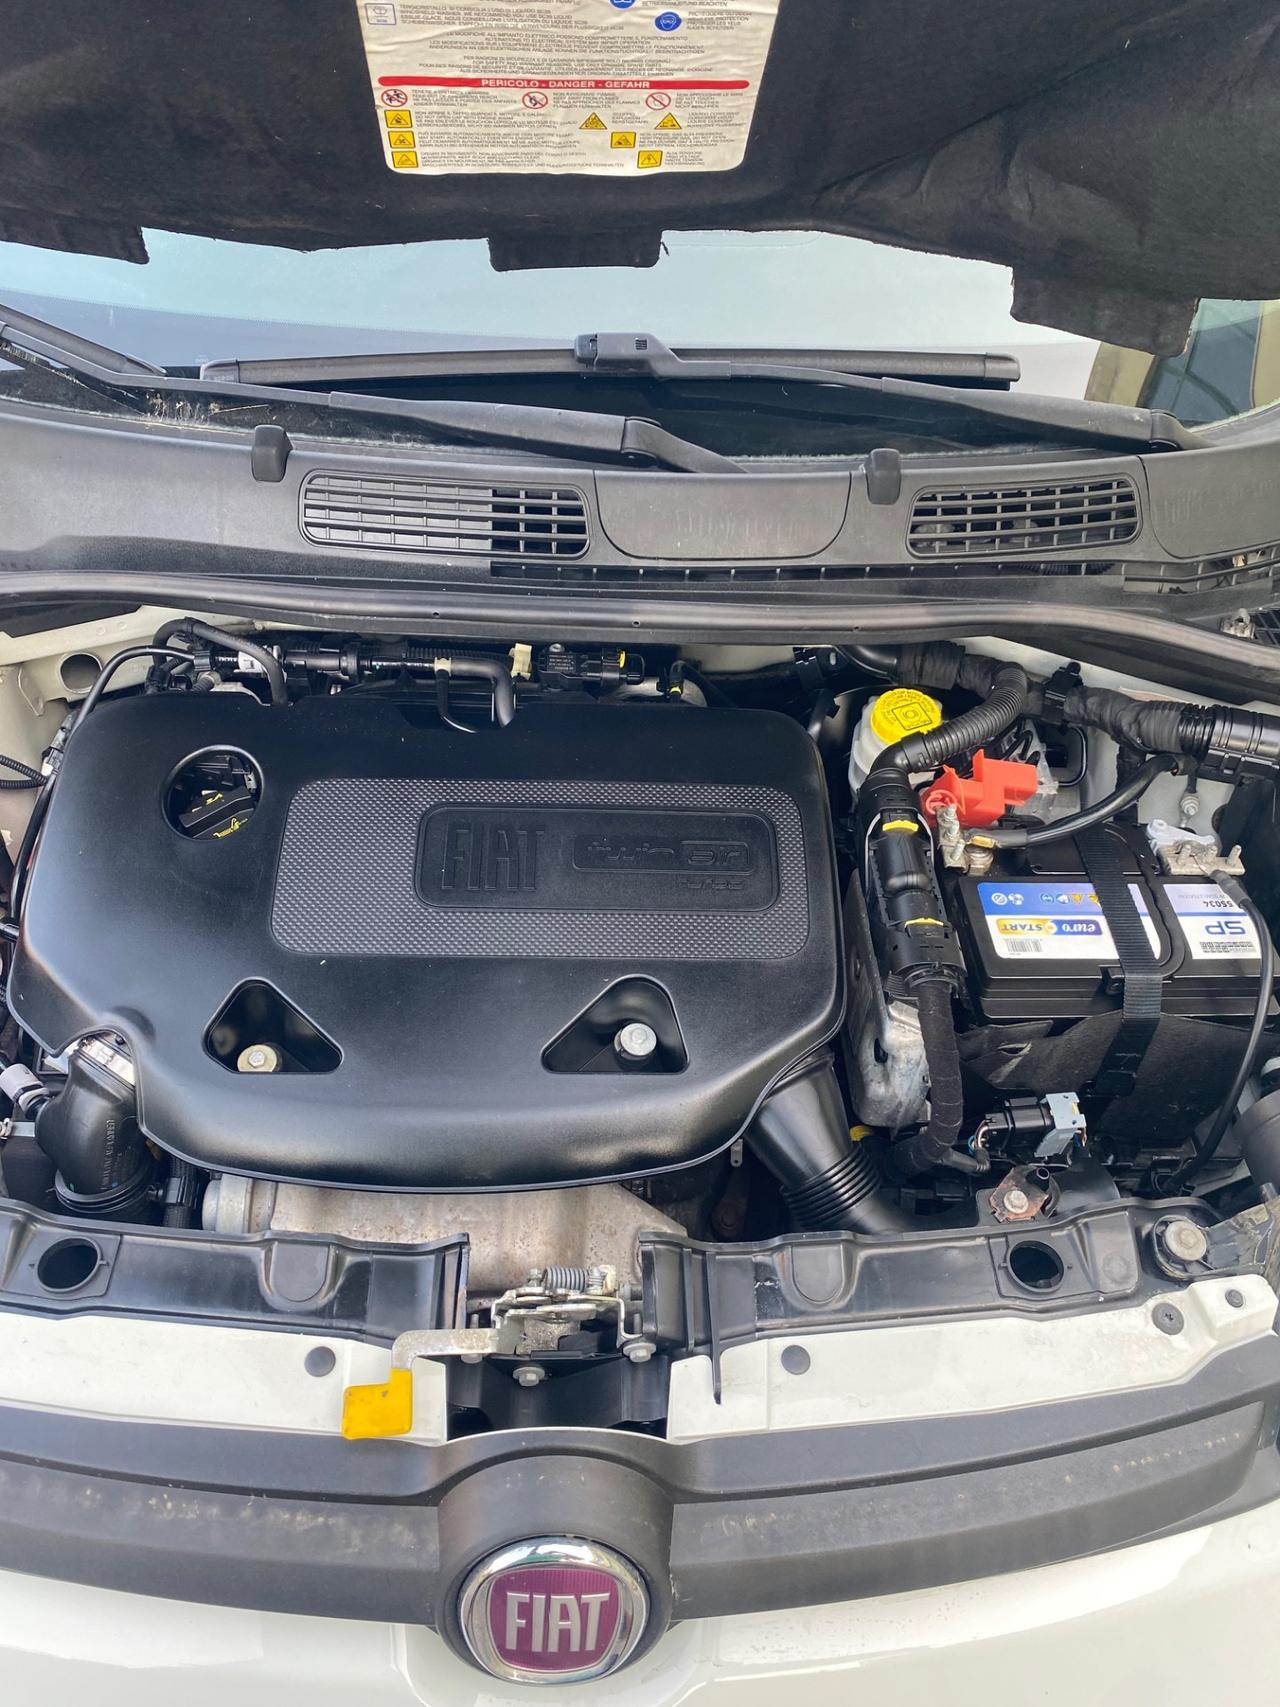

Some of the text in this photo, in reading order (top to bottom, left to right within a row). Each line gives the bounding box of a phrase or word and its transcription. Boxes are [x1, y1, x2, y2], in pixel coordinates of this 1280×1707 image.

[481, 79, 539, 88] PERICOLO
[604, 81, 650, 89] GEFAHR
[441, 822, 545, 892] FIAT
[1000, 922, 1097, 934] euro START
[1204, 920, 1247, 936] SP
[506, 1592, 610, 1652] FIAT
